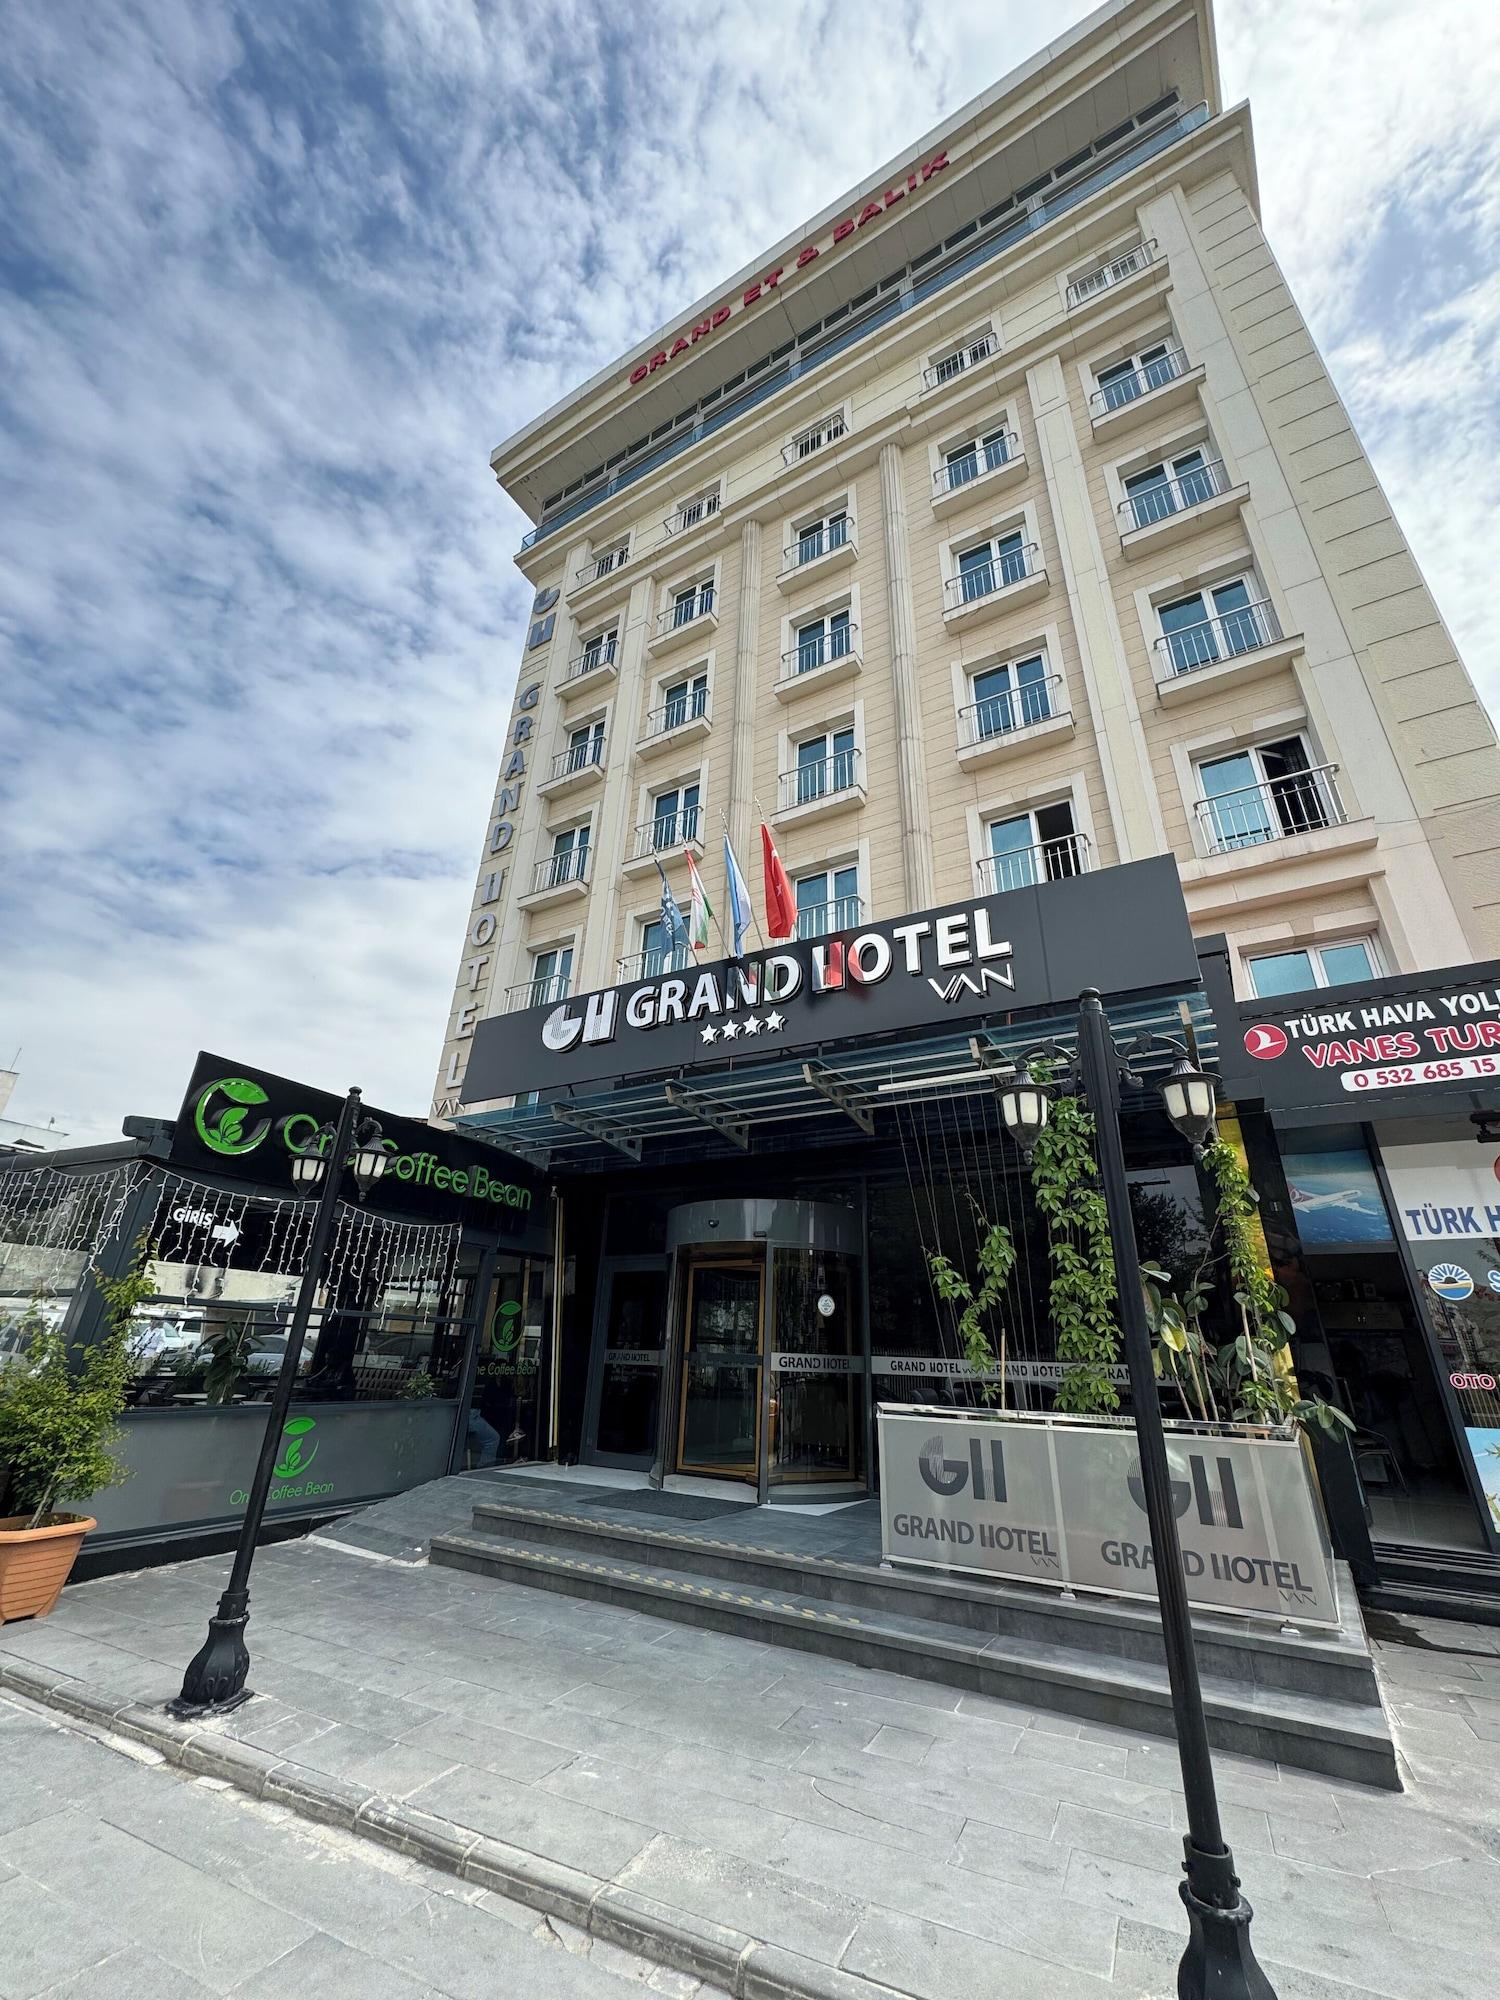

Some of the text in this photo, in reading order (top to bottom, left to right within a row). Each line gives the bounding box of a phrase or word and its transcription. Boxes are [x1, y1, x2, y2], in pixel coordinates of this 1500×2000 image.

[629, 150, 950, 385] GRAND ET & BALIK
[489, 681, 541, 854] GRAND
[445, 869, 504, 1089] HOTEL
[625, 955, 803, 1030] GRAND
[811, 907, 1013, 995] HOTEL
[927, 962, 1016, 1003] VAN
[1284, 989, 1500, 1039] TÜRK HAVA YOL
[1302, 1014, 1500, 1068] VANES TUR
[1376, 1068, 1416, 1085] 532
[1423, 1062, 1464, 1079] 685
[1470, 1058, 1496, 1074] 15
[473, 1166, 533, 1211] Bean
[1405, 1203, 1483, 1235] TÜRK
[487, 1361, 516, 1376] Coffee
[778, 1356, 821, 1369] GRAND
[890, 1360, 961, 1374] GRAND HOTEL
[1450, 1372, 1497, 1390] OTO
[304, 1481, 335, 1496] Bean
[893, 1513, 1057, 1558] GRAND HOTEL
[1101, 1540, 1314, 1593] GRAD HOTEL
